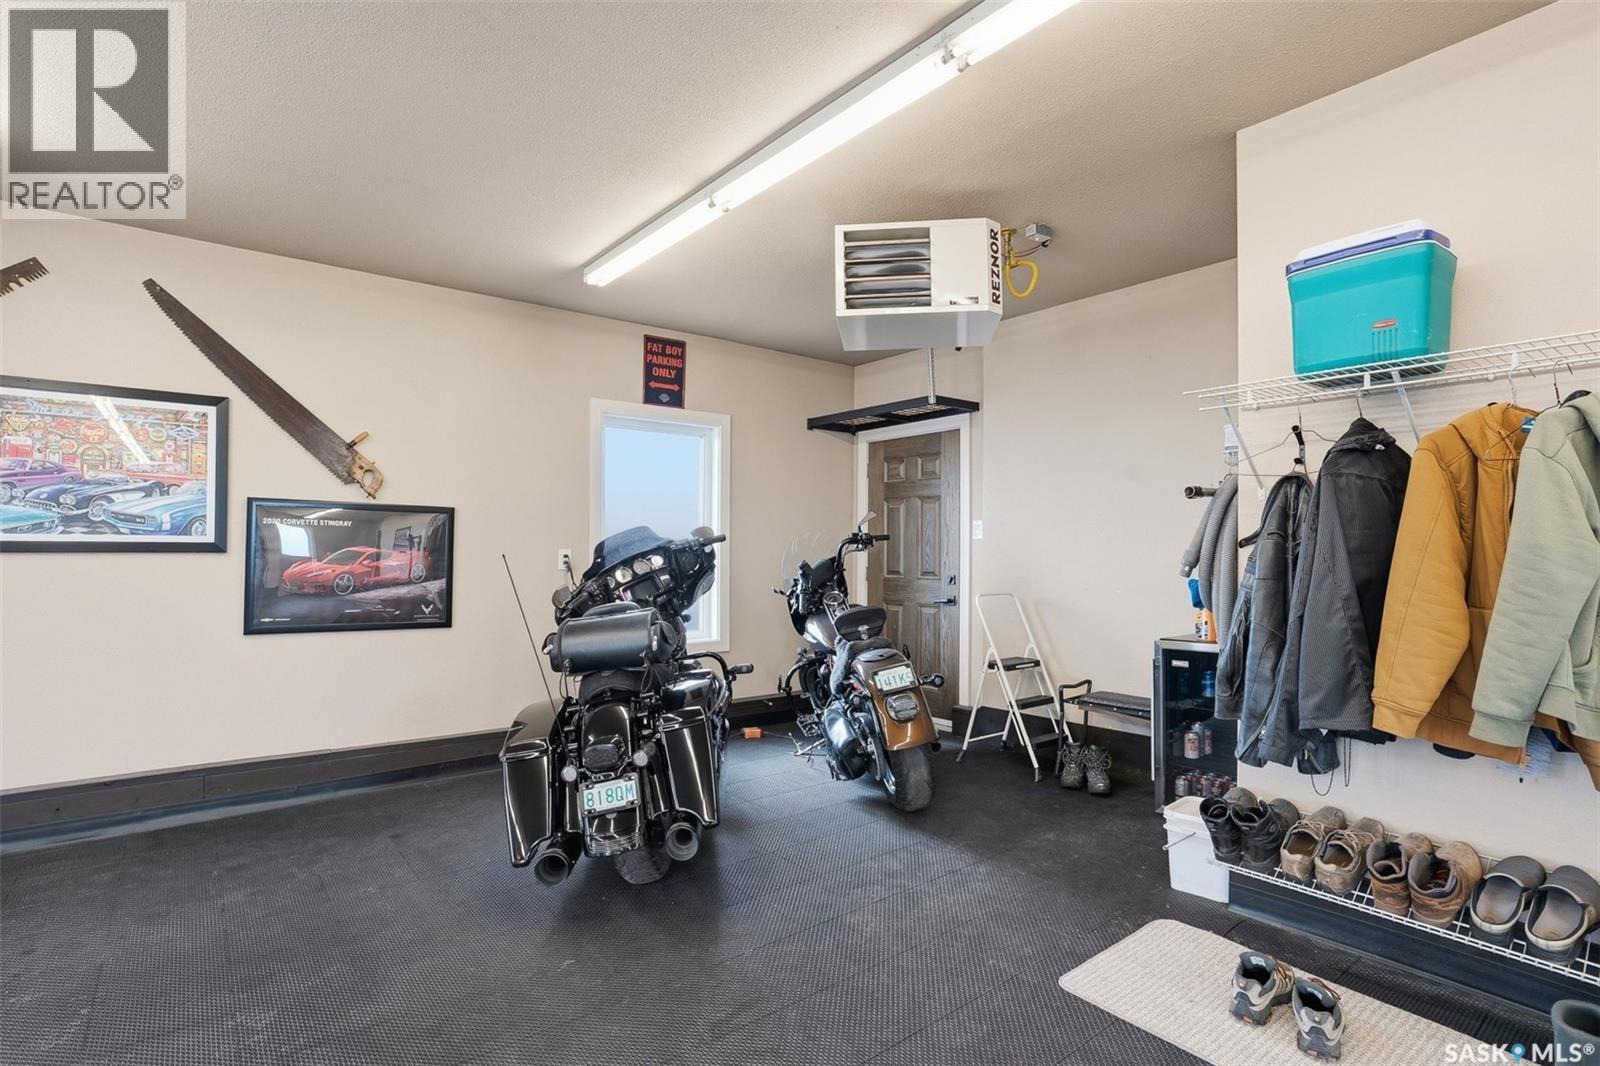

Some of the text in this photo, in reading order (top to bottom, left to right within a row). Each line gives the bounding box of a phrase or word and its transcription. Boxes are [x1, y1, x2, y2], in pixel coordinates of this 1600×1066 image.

[990, 228, 1001, 304] REZNOR
[647, 342, 683, 356] FAT BOY
[646, 354, 683, 368] PARKING
[652, 367, 677, 378] ONLY
[262, 517, 281, 525] 2020
[586, 784, 634, 807] 818QM
